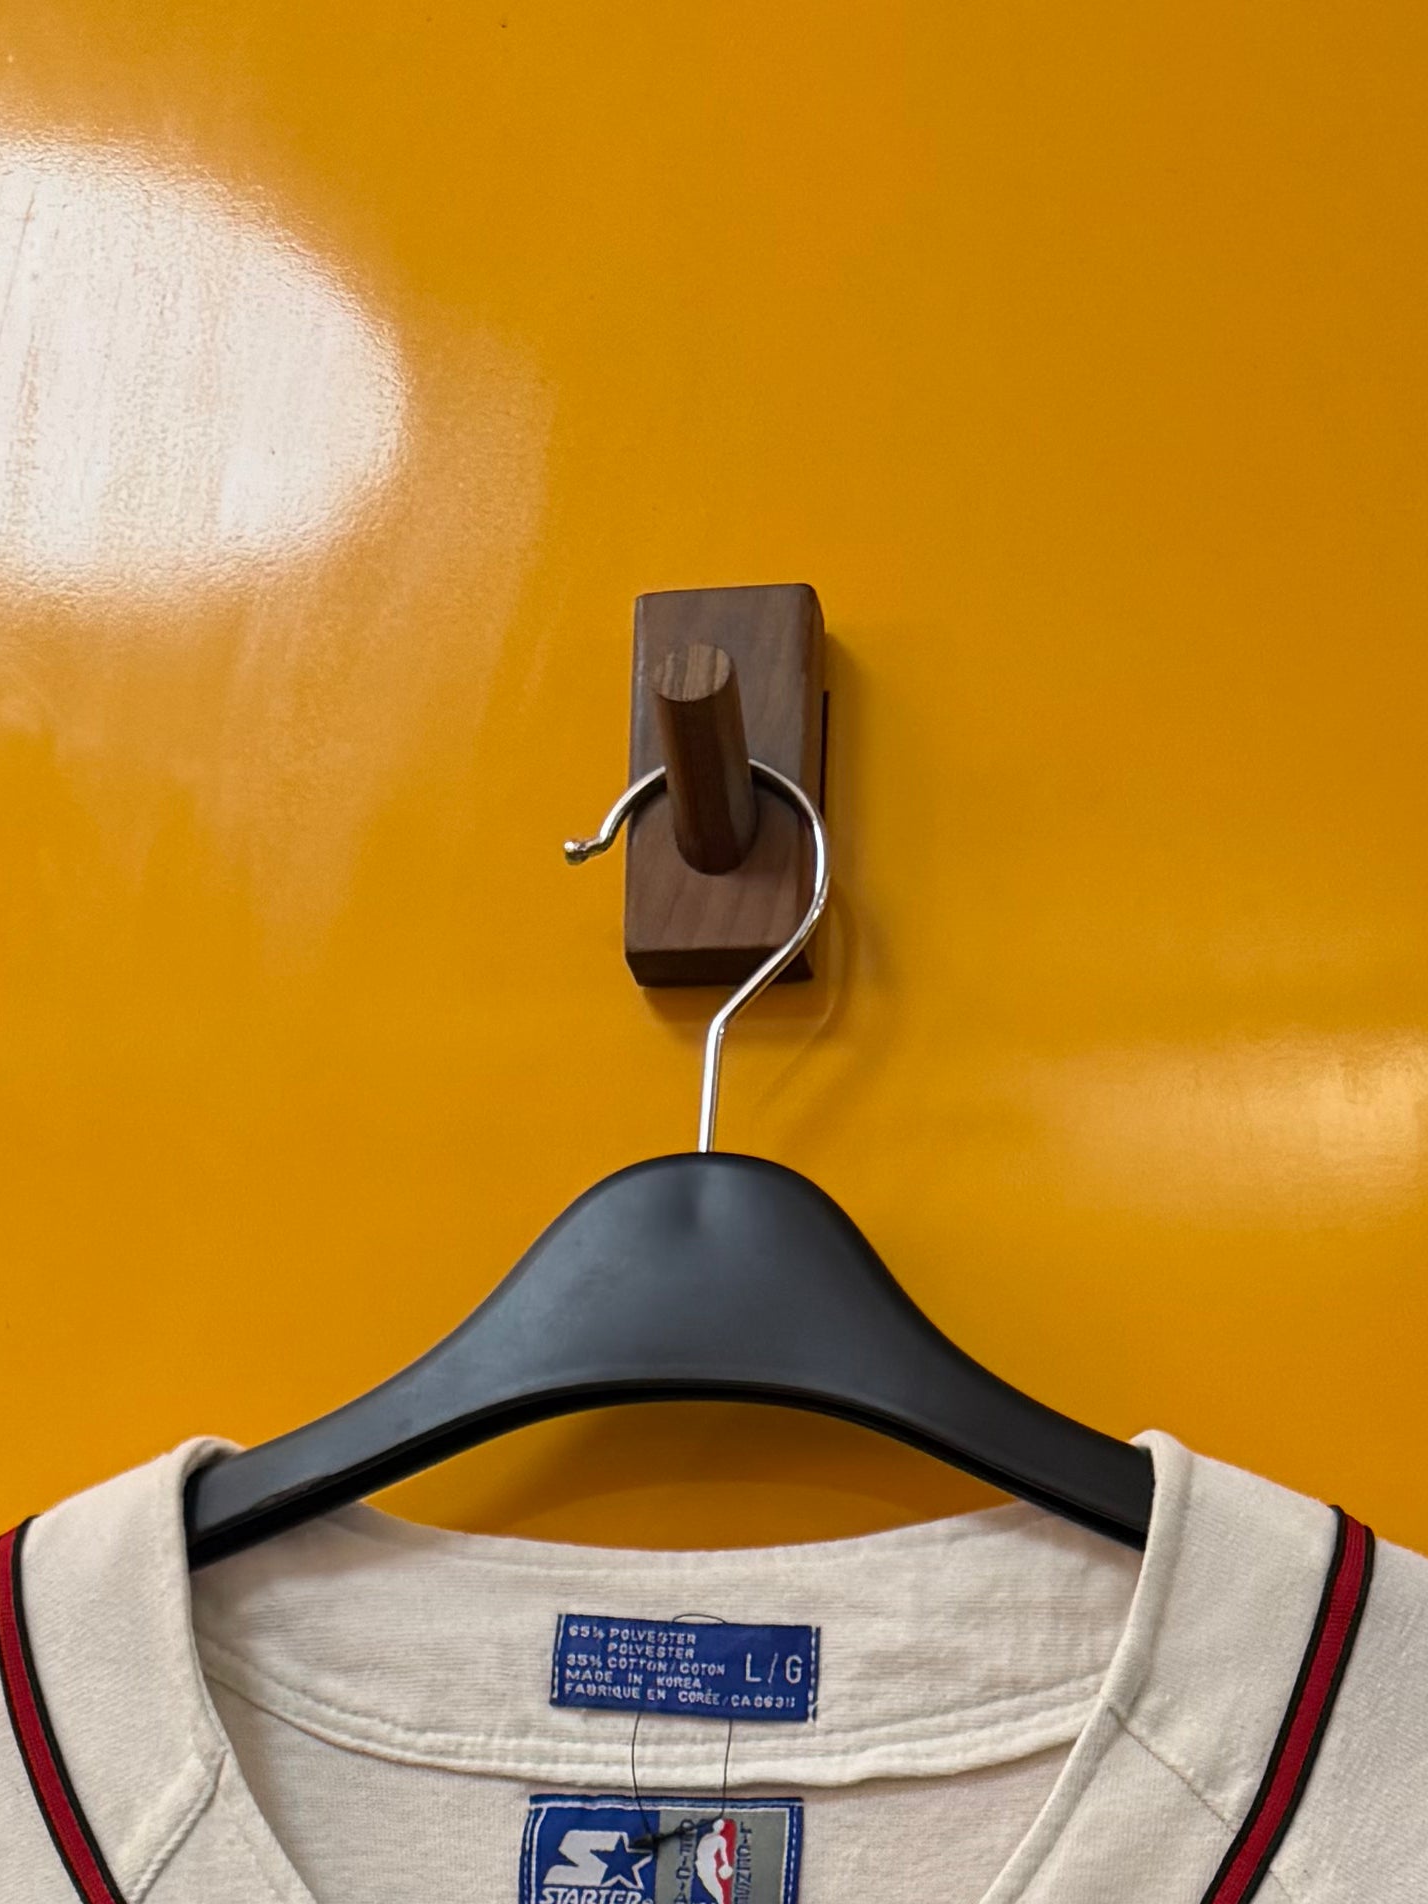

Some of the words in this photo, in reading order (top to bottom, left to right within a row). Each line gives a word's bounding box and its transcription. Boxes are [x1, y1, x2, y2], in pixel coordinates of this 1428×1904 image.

[606, 1642, 695, 1660] POLYESTER
[564, 1669, 613, 1683] MADE
[627, 1673, 643, 1685] IN
[656, 1675, 702, 1690] KOREA
[563, 1683, 640, 1700] FABRIQUE
[646, 1689, 666, 1701] EN
